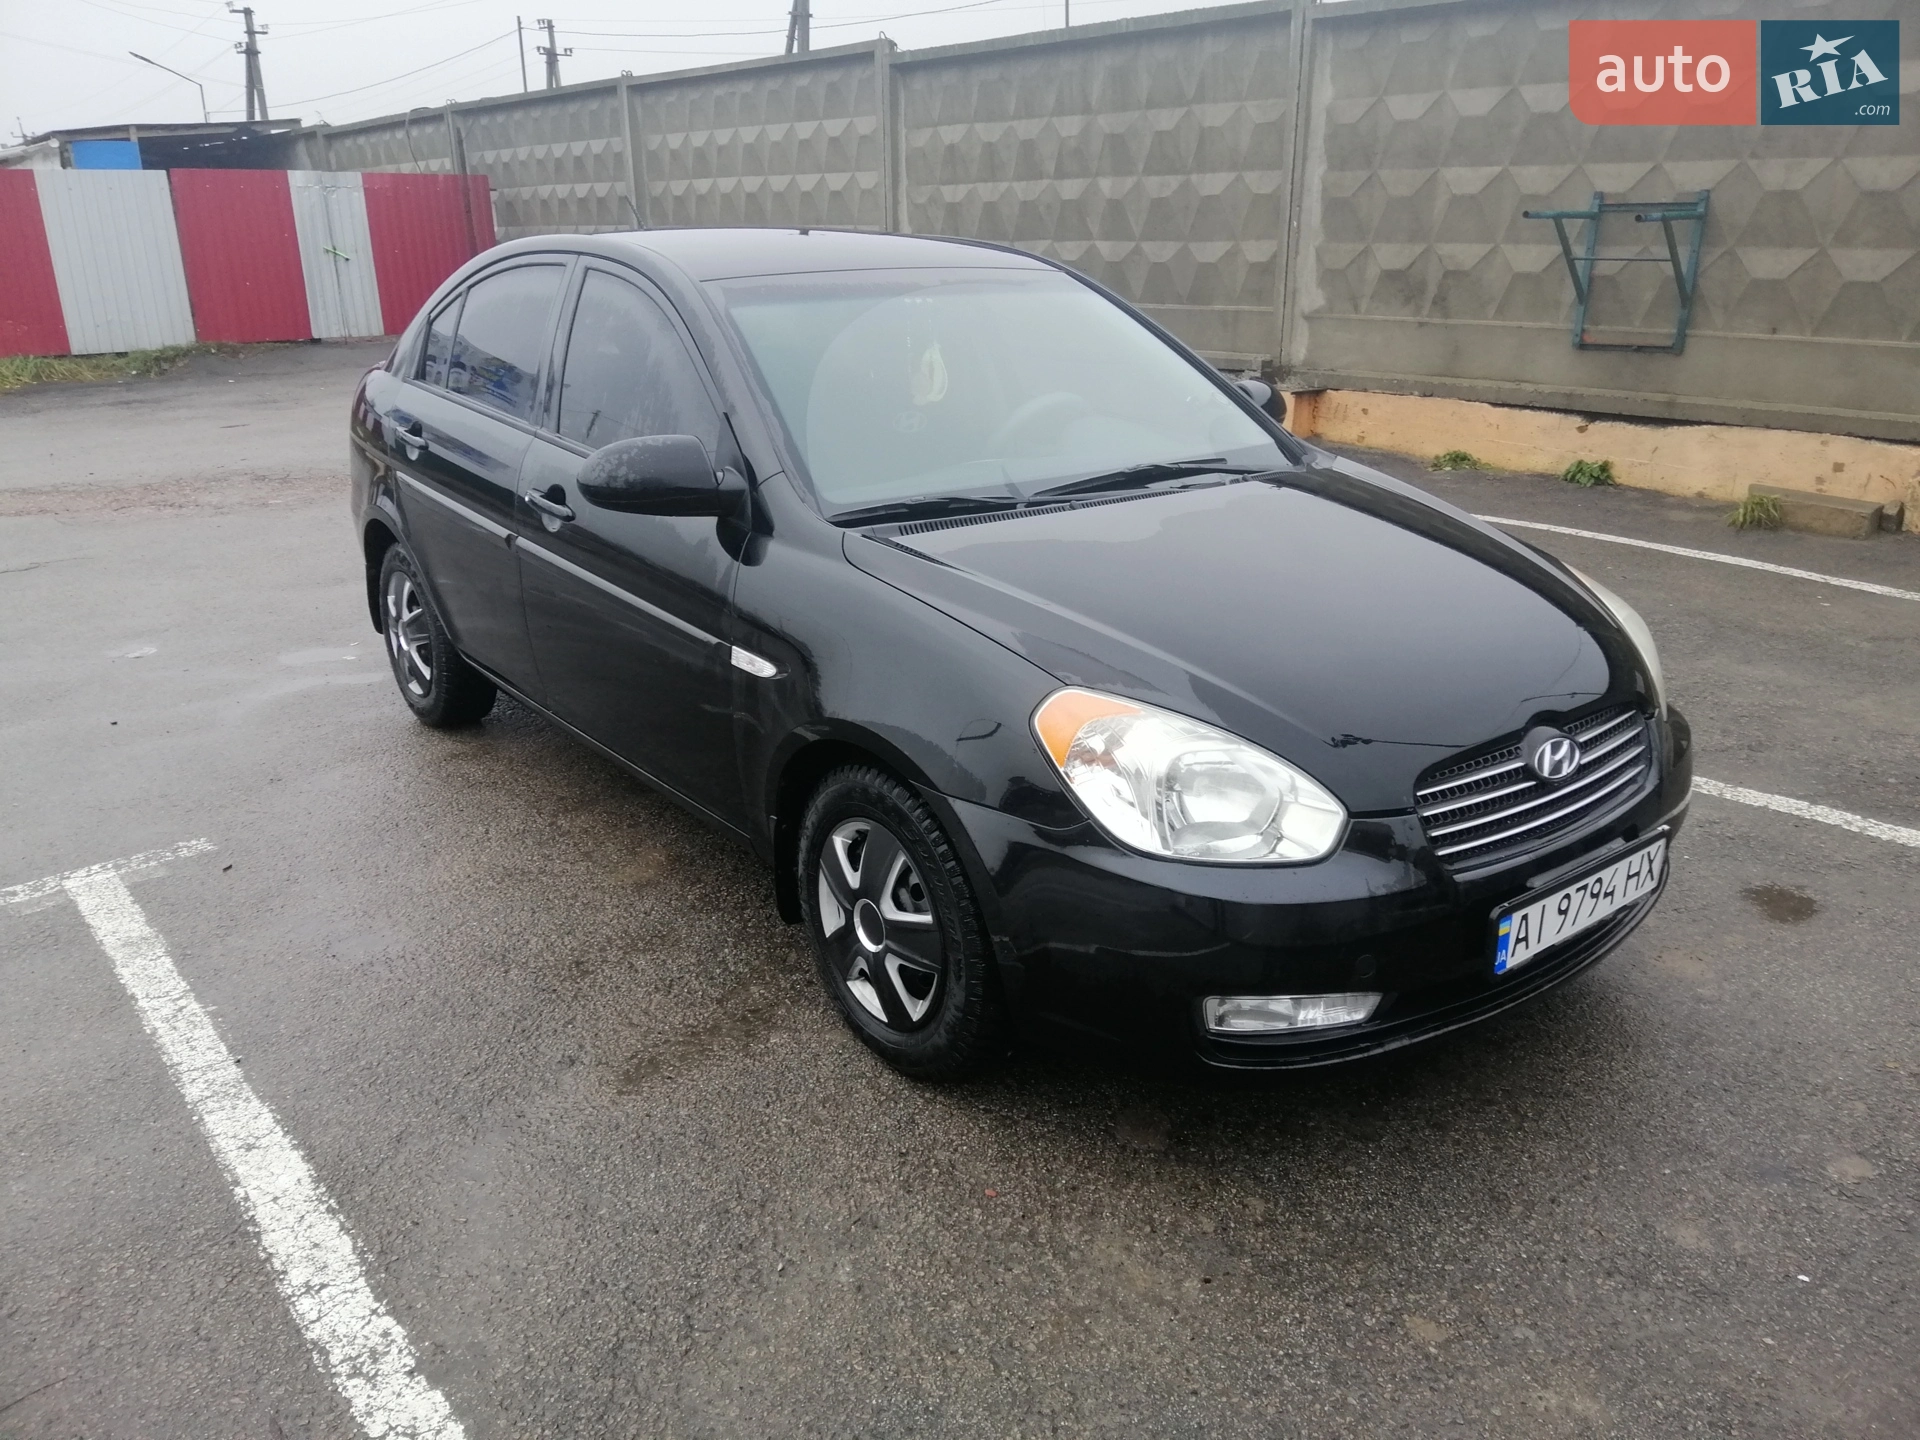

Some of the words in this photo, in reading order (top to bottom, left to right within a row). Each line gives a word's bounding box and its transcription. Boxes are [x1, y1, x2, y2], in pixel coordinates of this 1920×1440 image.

[1511, 904, 1546, 958] AI
[1555, 867, 1619, 936] 9794
[1623, 844, 1662, 898] HX
